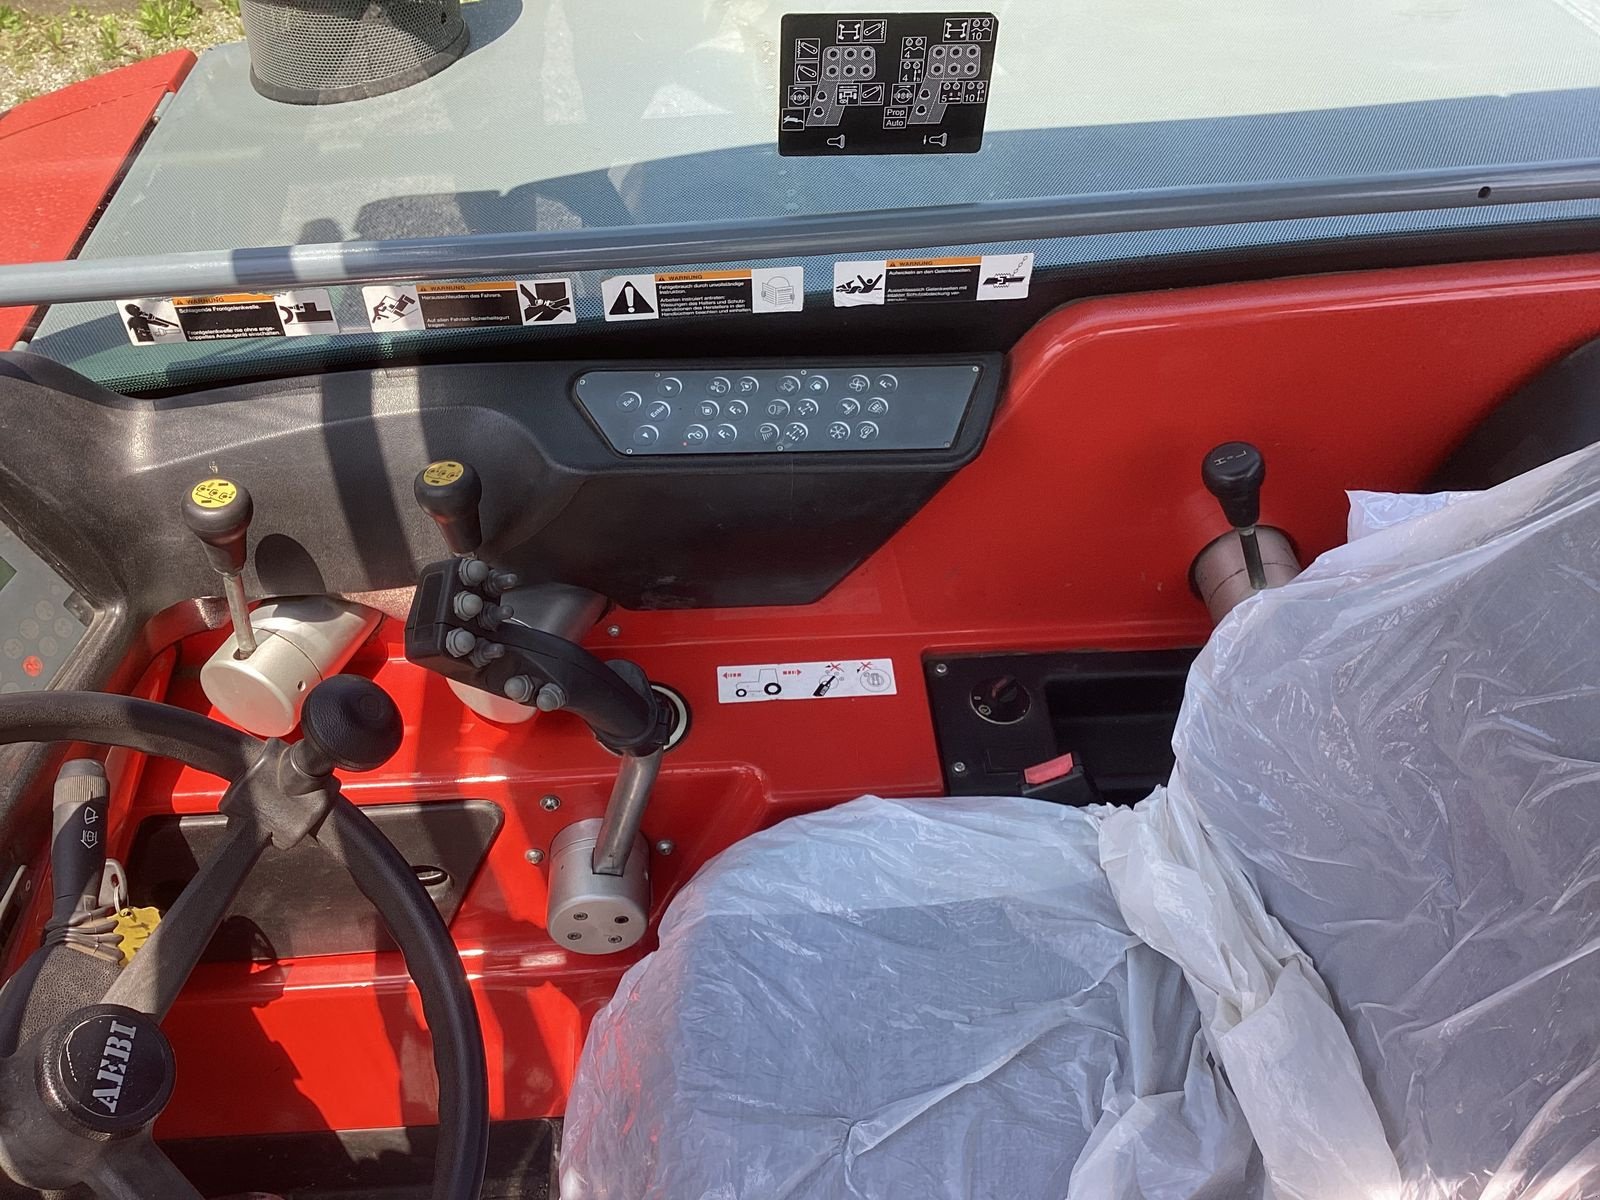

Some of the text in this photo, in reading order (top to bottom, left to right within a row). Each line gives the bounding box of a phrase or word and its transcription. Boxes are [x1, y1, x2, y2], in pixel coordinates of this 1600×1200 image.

[887, 109, 905, 117] Prop
[650, 405, 665, 418] Enter
[92, 1020, 136, 1113] AEBI
